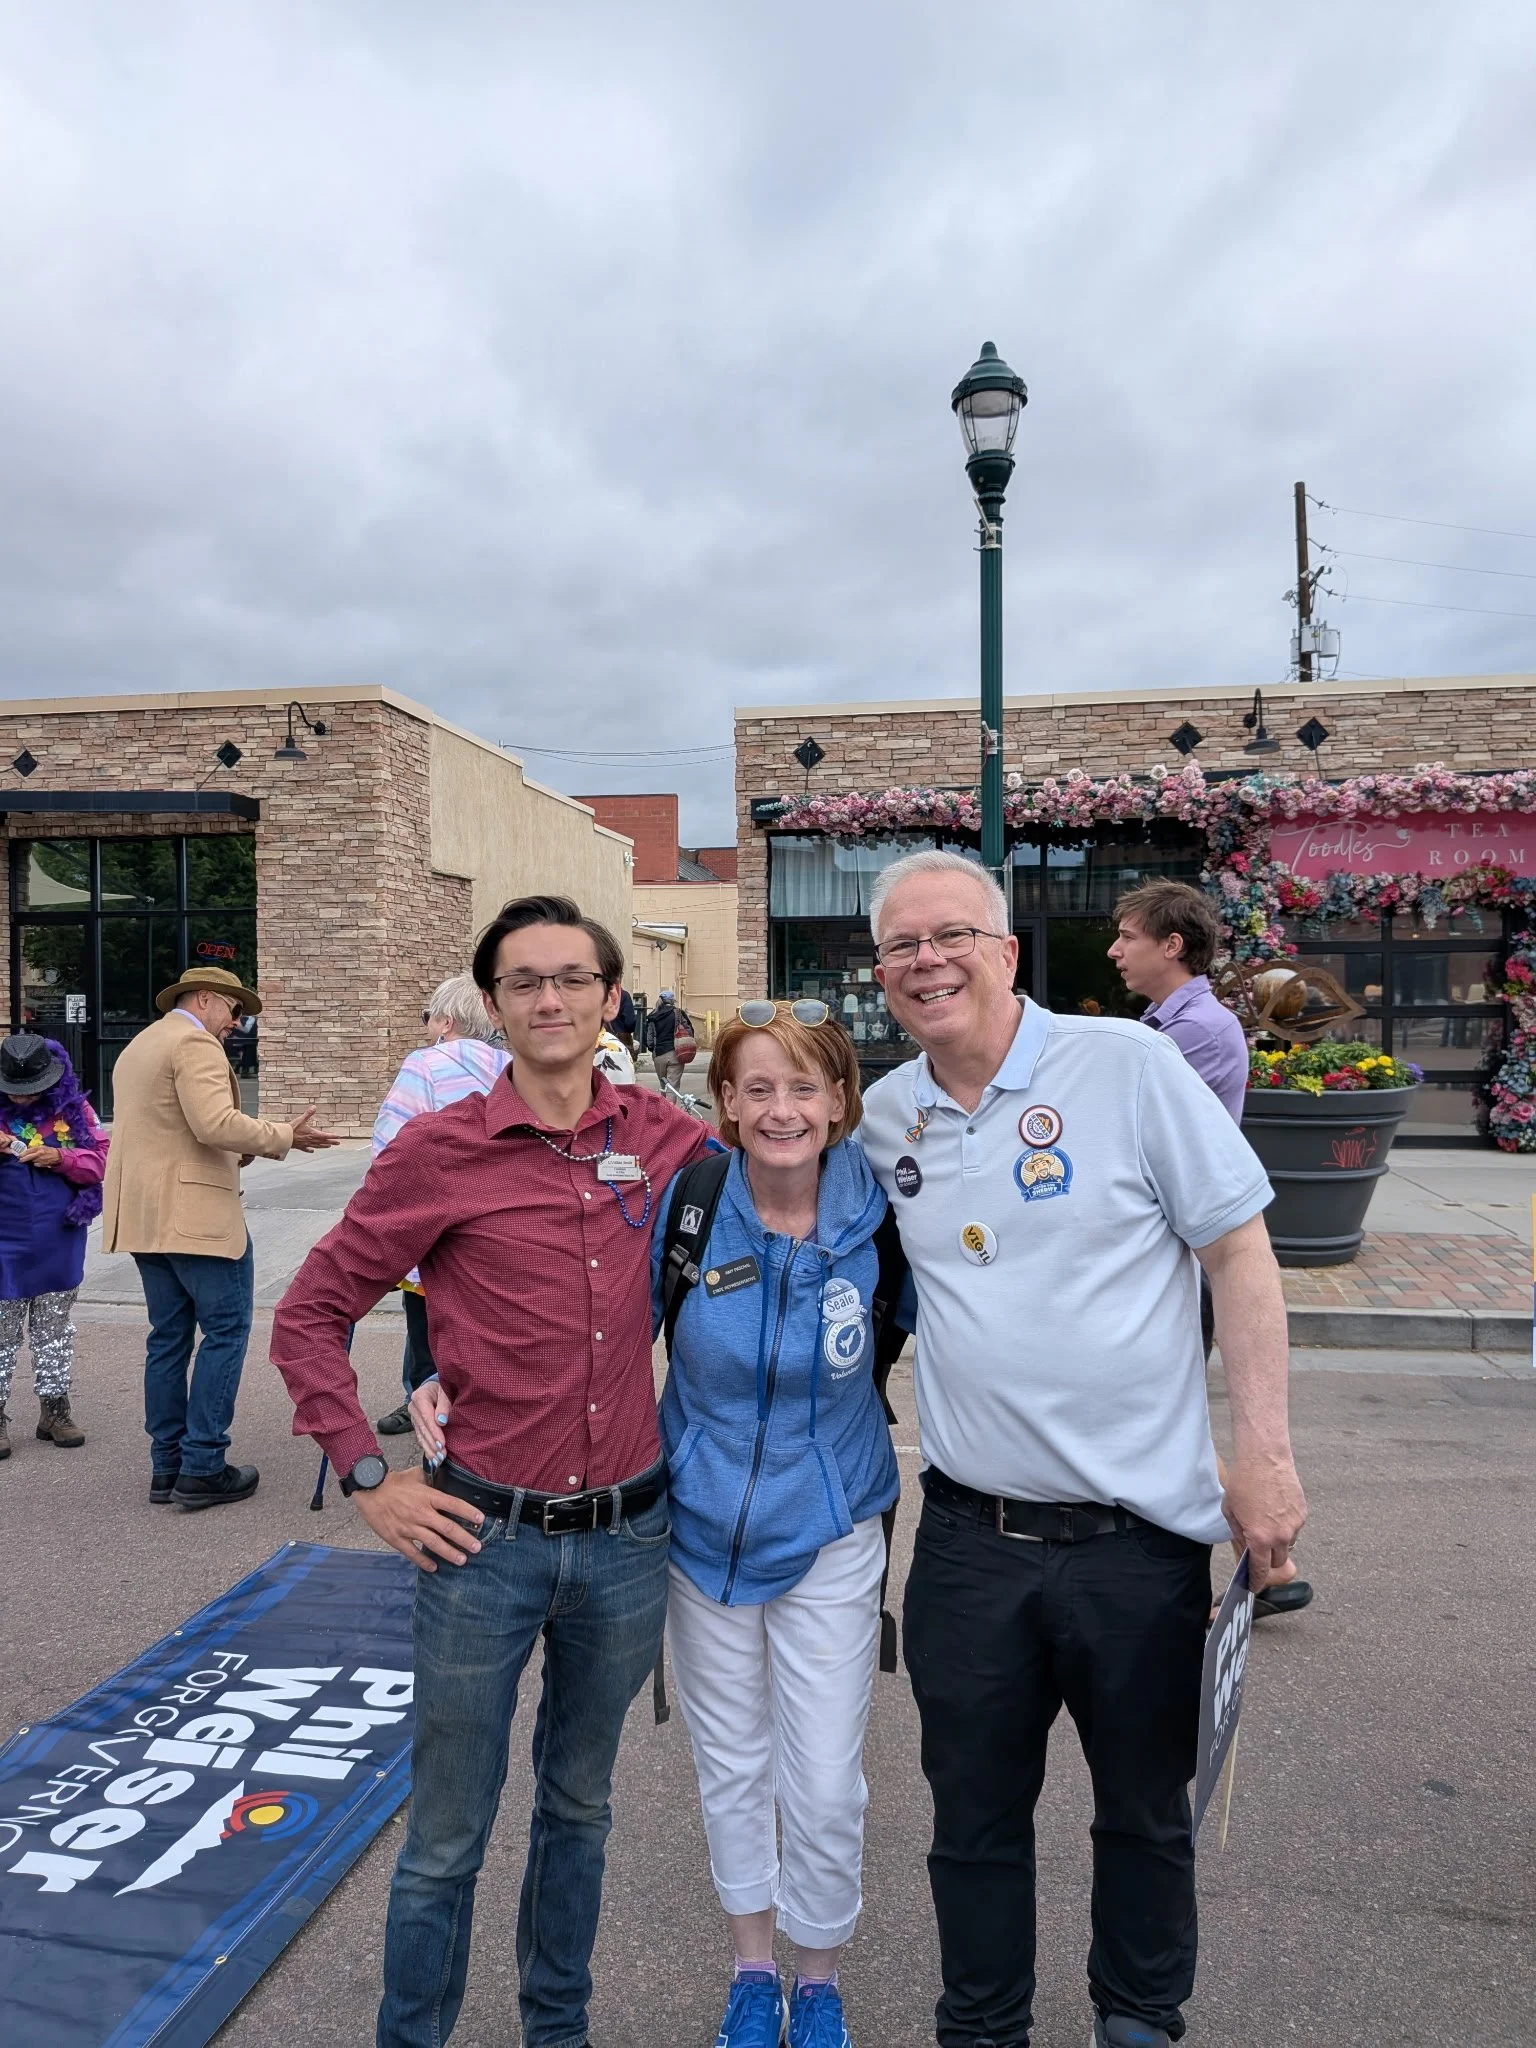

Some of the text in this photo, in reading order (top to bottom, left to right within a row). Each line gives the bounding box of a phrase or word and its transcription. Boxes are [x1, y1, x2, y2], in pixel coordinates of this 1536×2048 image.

[1445, 822, 1509, 839] TEA
[1274, 817, 1409, 875] Toodles
[1429, 848, 1525, 866] ROOM
[196, 942, 237, 959] OPEN
[896, 1167, 908, 1177] Phil
[897, 1174, 918, 1184] Weiser
[967, 1226, 991, 1264] VIGIL
[826, 1293, 855, 1313] Seale
[160, 1651, 249, 1704] FOR
[251, 1666, 415, 1780] Phil
[6, 1666, 344, 1893] Weiser
